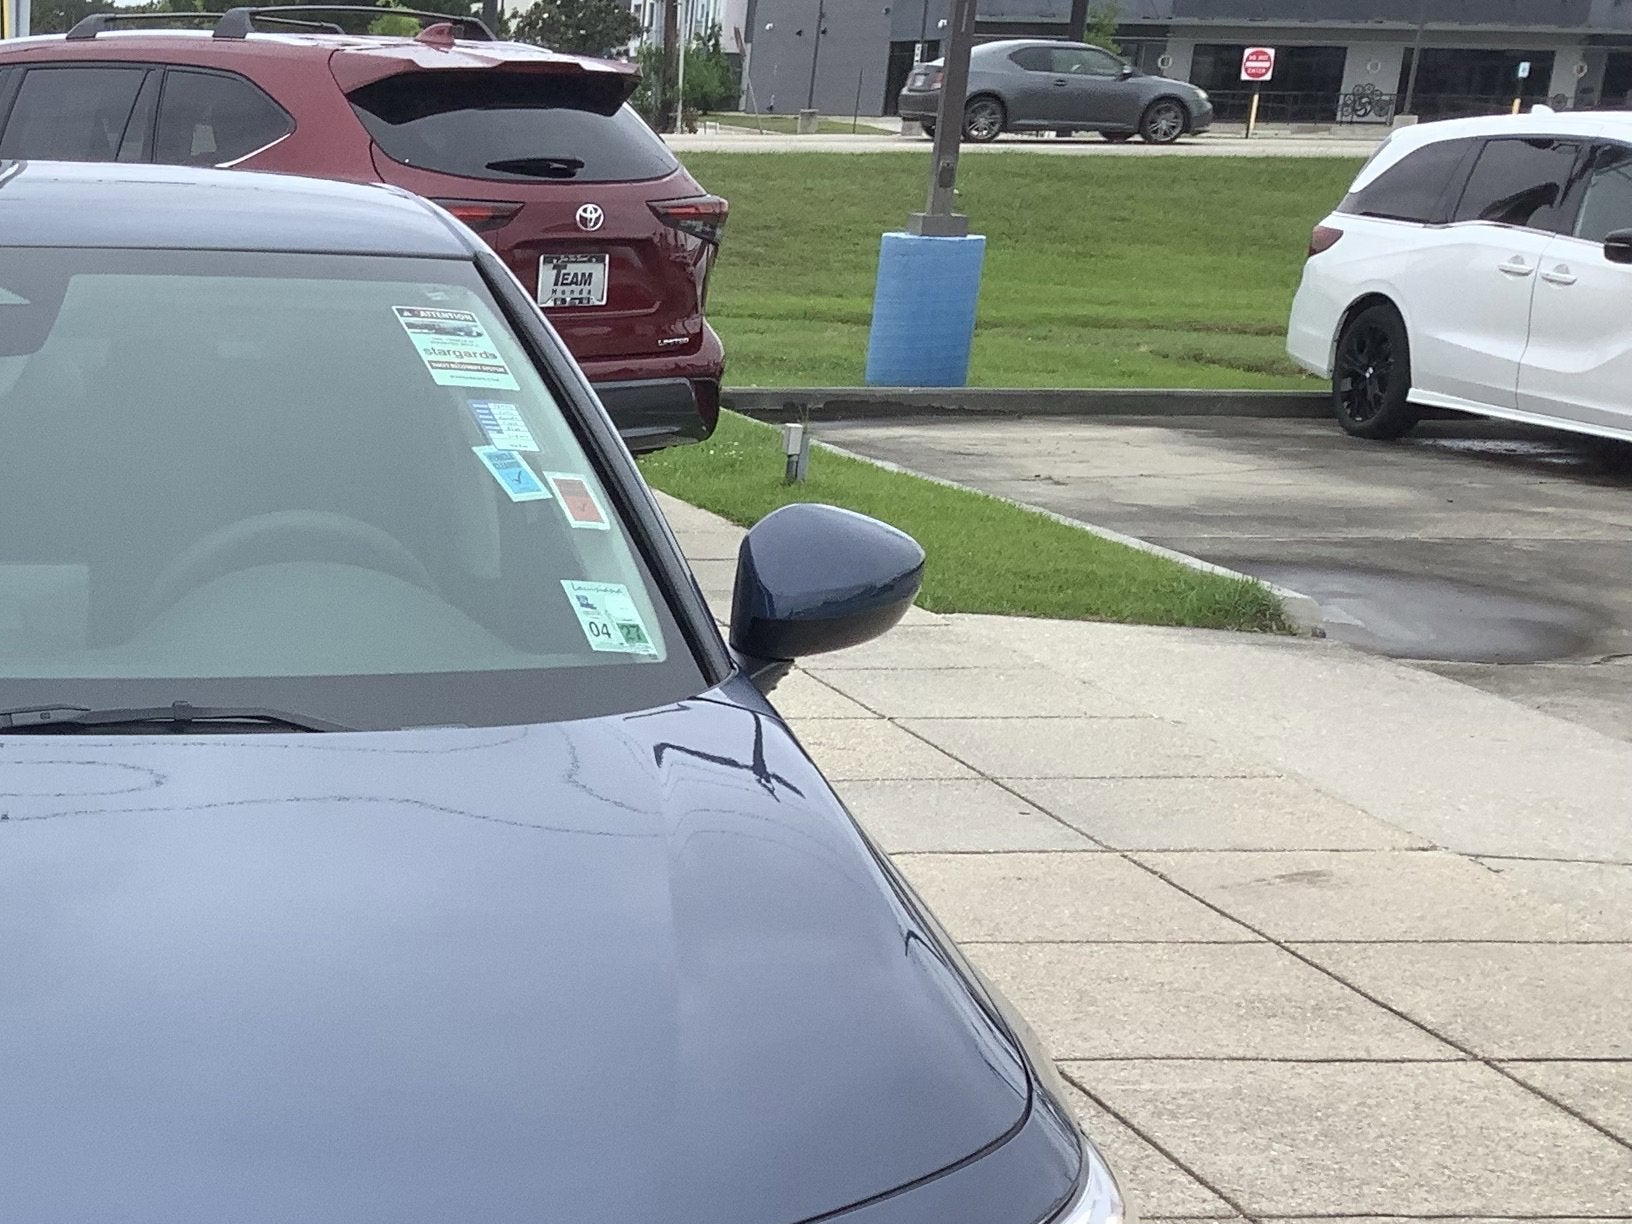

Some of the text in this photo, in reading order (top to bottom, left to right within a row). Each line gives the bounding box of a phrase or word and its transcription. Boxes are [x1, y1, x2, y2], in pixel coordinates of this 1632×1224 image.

[552, 264, 593, 286] TEAM
[419, 310, 473, 321] ATTENTION
[588, 621, 643, 641] 04 27
